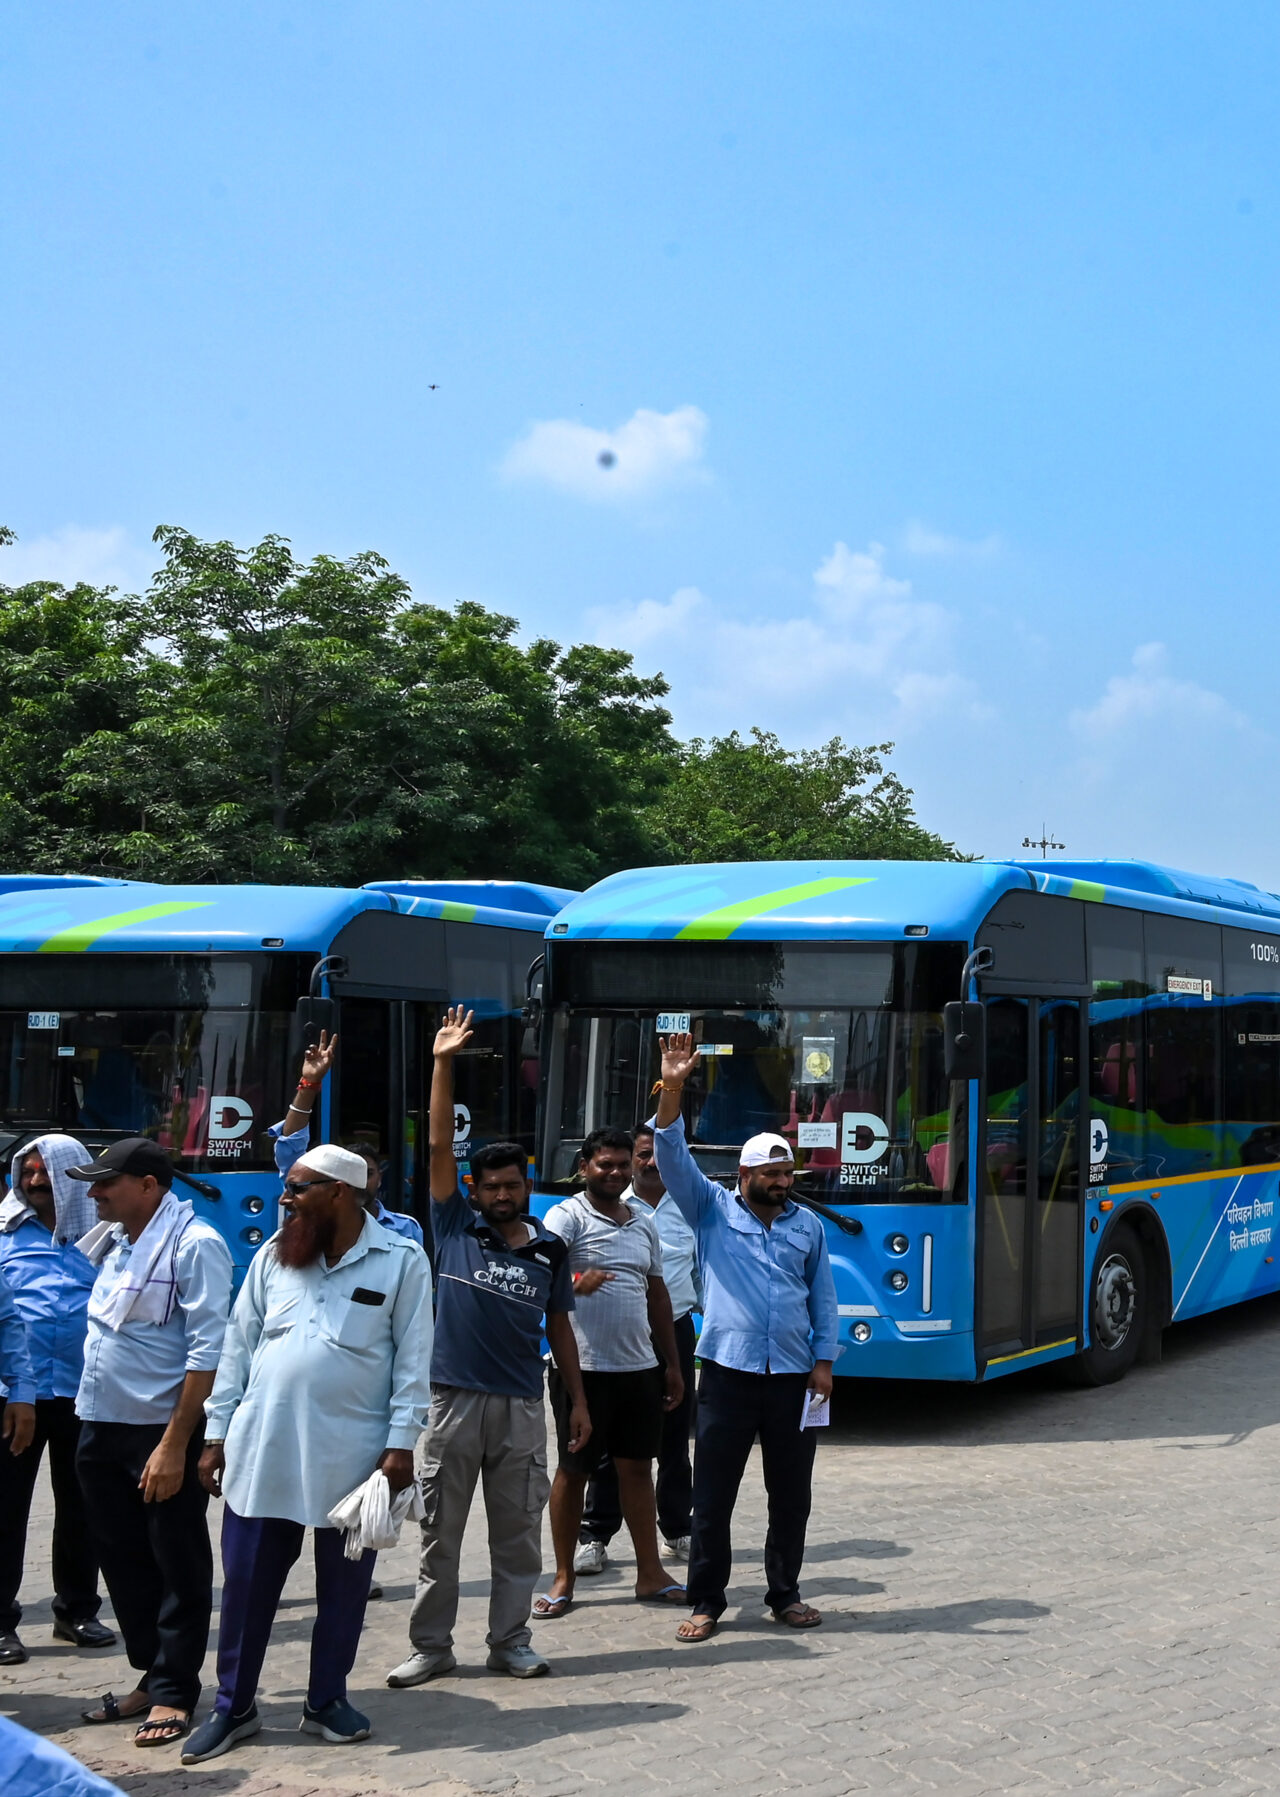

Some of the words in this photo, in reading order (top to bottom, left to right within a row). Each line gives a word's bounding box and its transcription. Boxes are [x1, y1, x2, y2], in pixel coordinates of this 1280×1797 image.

[1250, 943, 1279, 963] 100%
[48, 1014, 59, 1027] (E)
[657, 1015, 676, 1030] RJD-1
[677, 1015, 689, 1030] (E)
[208, 1140, 252, 1149] SWITCH
[207, 1149, 241, 1157] DELHI
[840, 1165, 888, 1175] SWITCH
[1089, 1163, 1108, 1174] SWITCH
[840, 1175, 876, 1185] DELHI
[1089, 1172, 1104, 1183] DELHI
[1227, 1202, 1252, 1224] परिवहन
[1253, 1198, 1274, 1220] विभाग
[1229, 1227, 1249, 1252] दिल्ली
[1249, 1227, 1272, 1247] सरकार
